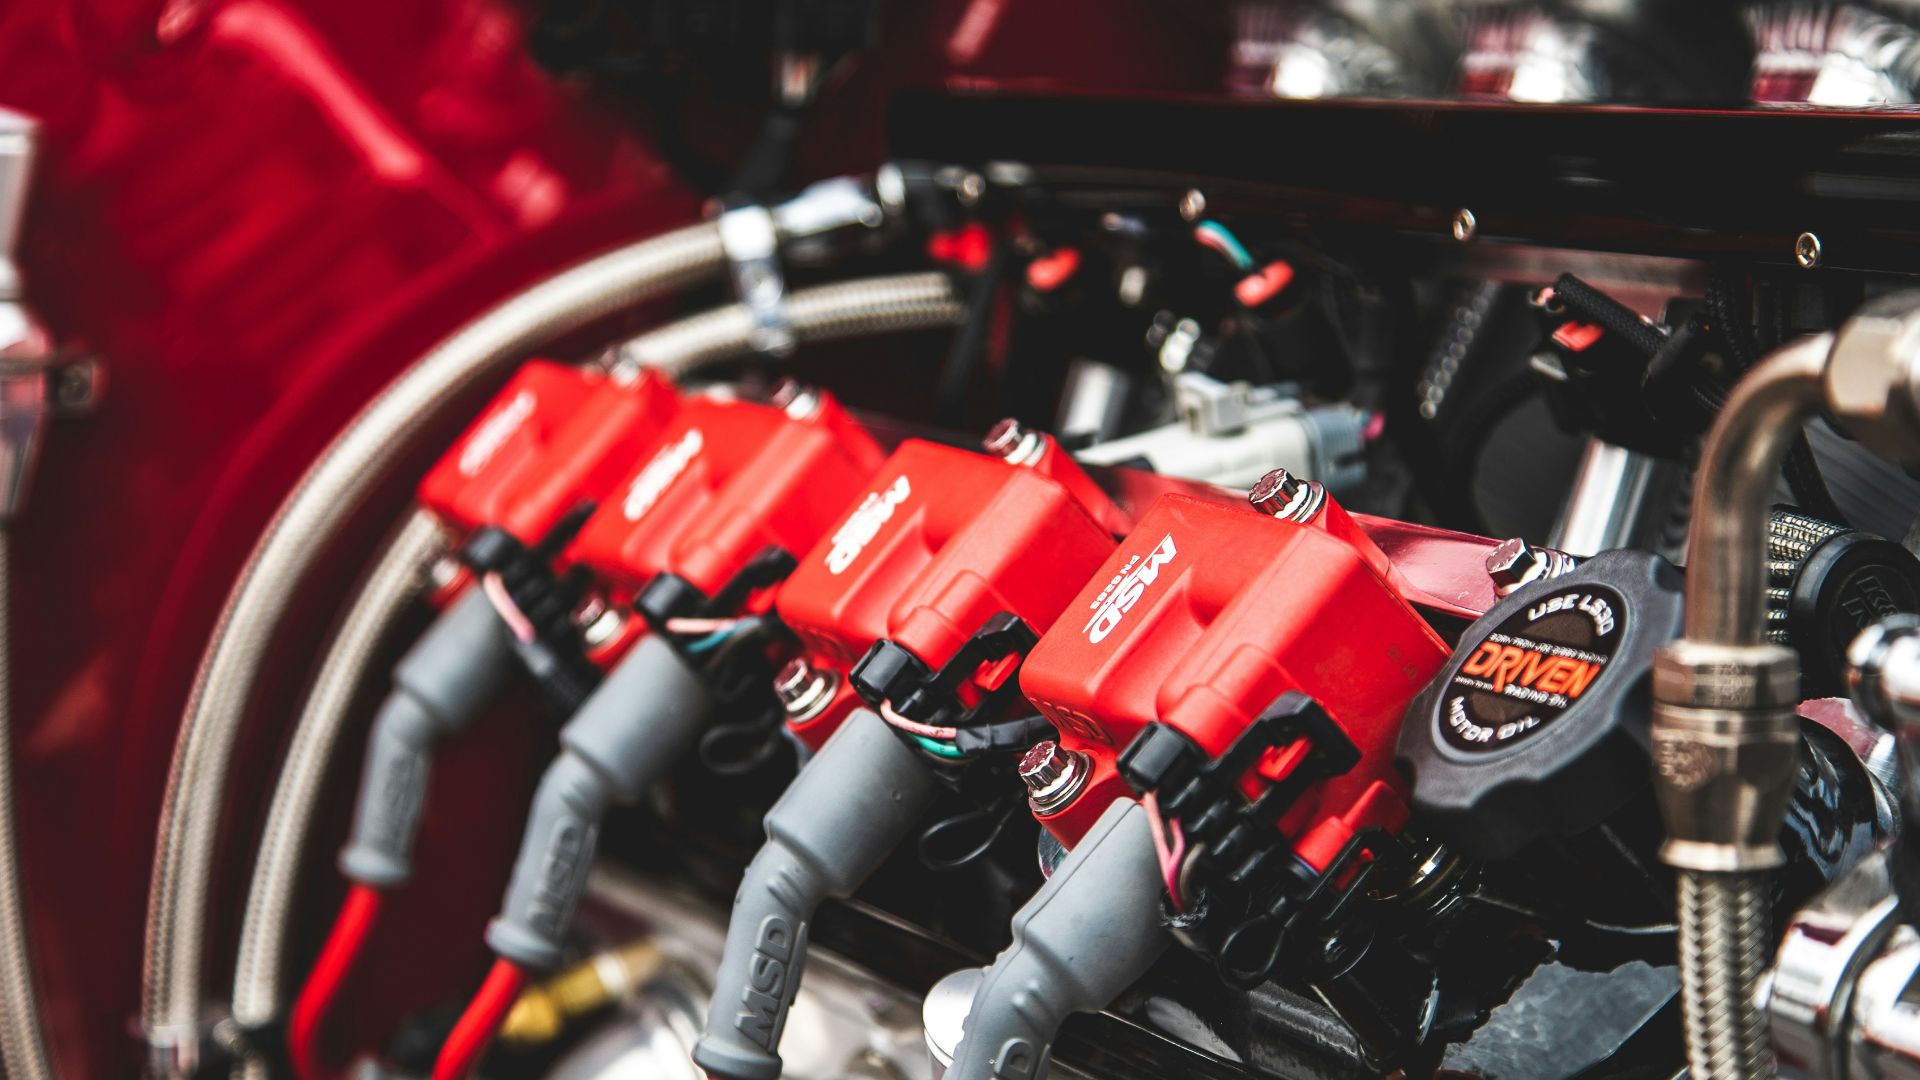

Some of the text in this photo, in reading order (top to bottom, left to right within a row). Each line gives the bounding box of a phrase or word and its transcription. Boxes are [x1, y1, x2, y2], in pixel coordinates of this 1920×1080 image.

[1087, 533, 1177, 644] MSD
[1119, 554, 1140, 575] PN
[1527, 593, 1580, 621] USE
[1462, 640, 1601, 698] DRIVEN
[1449, 695, 1541, 742] MOTOR OIL
[735, 914, 793, 1049] MSD
